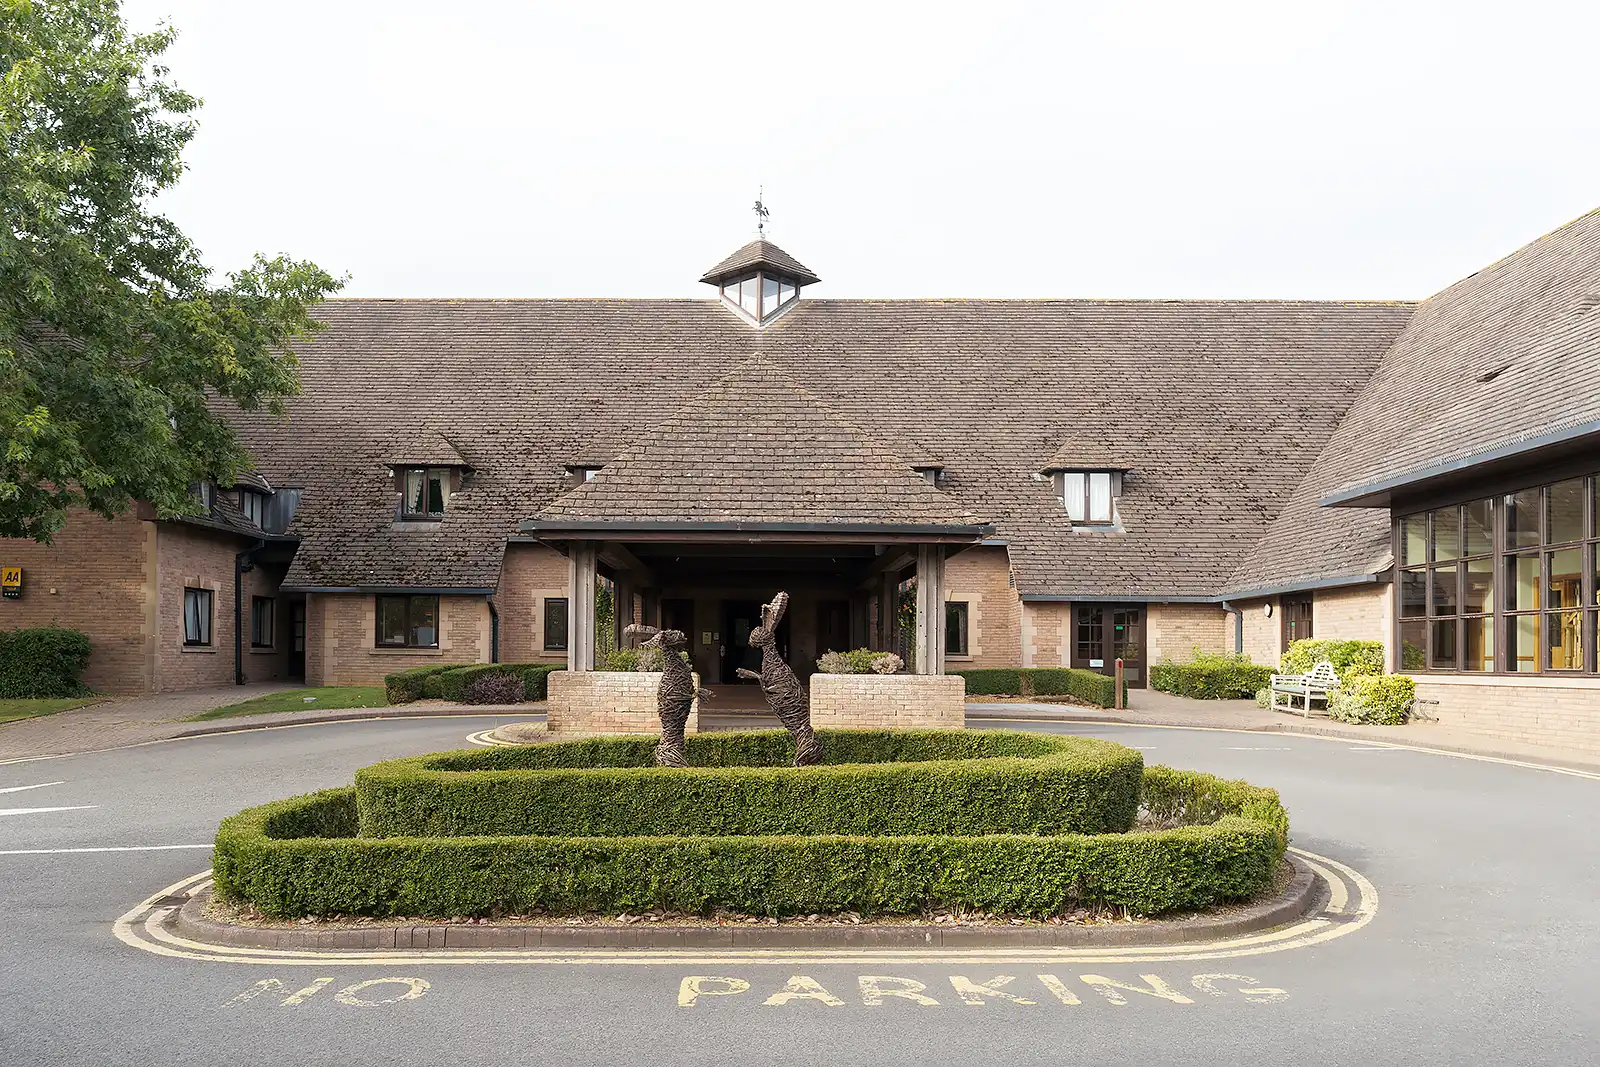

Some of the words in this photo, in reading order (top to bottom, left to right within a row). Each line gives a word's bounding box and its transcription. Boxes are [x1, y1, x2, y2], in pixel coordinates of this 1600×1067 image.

[5, 571, 19, 582] AA
[220, 976, 432, 1008] NO
[677, 973, 1291, 1007] PARKING
